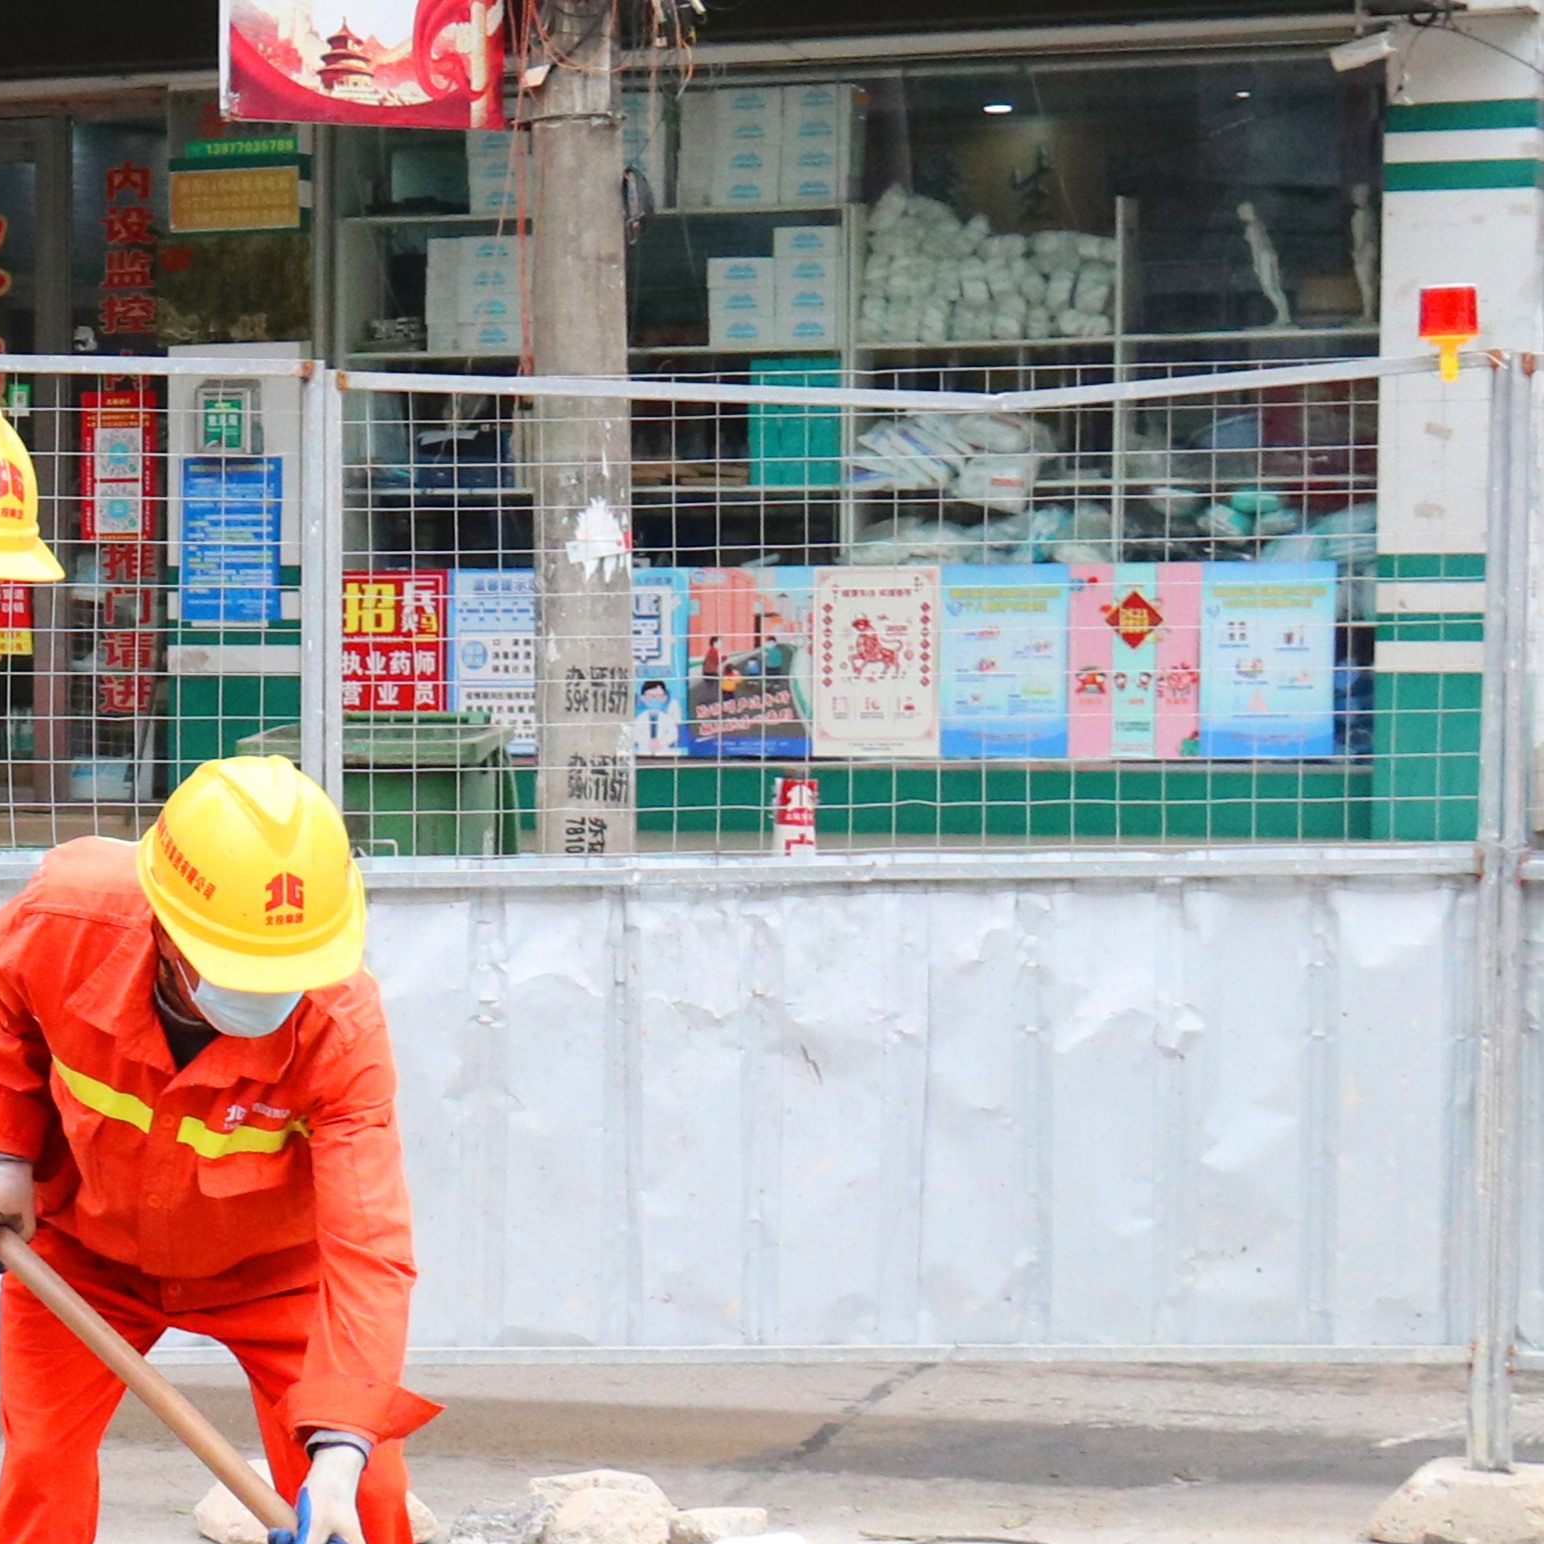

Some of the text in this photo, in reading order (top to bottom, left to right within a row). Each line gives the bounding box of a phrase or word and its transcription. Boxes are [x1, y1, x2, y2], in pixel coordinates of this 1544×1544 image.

[100, 159, 157, 335] 内设监控
[99, 543, 157, 714] 推门请进
[343, 582, 397, 634] 招
[342, 651, 437, 676] 执业药师
[342, 680, 437, 705] 营业员
